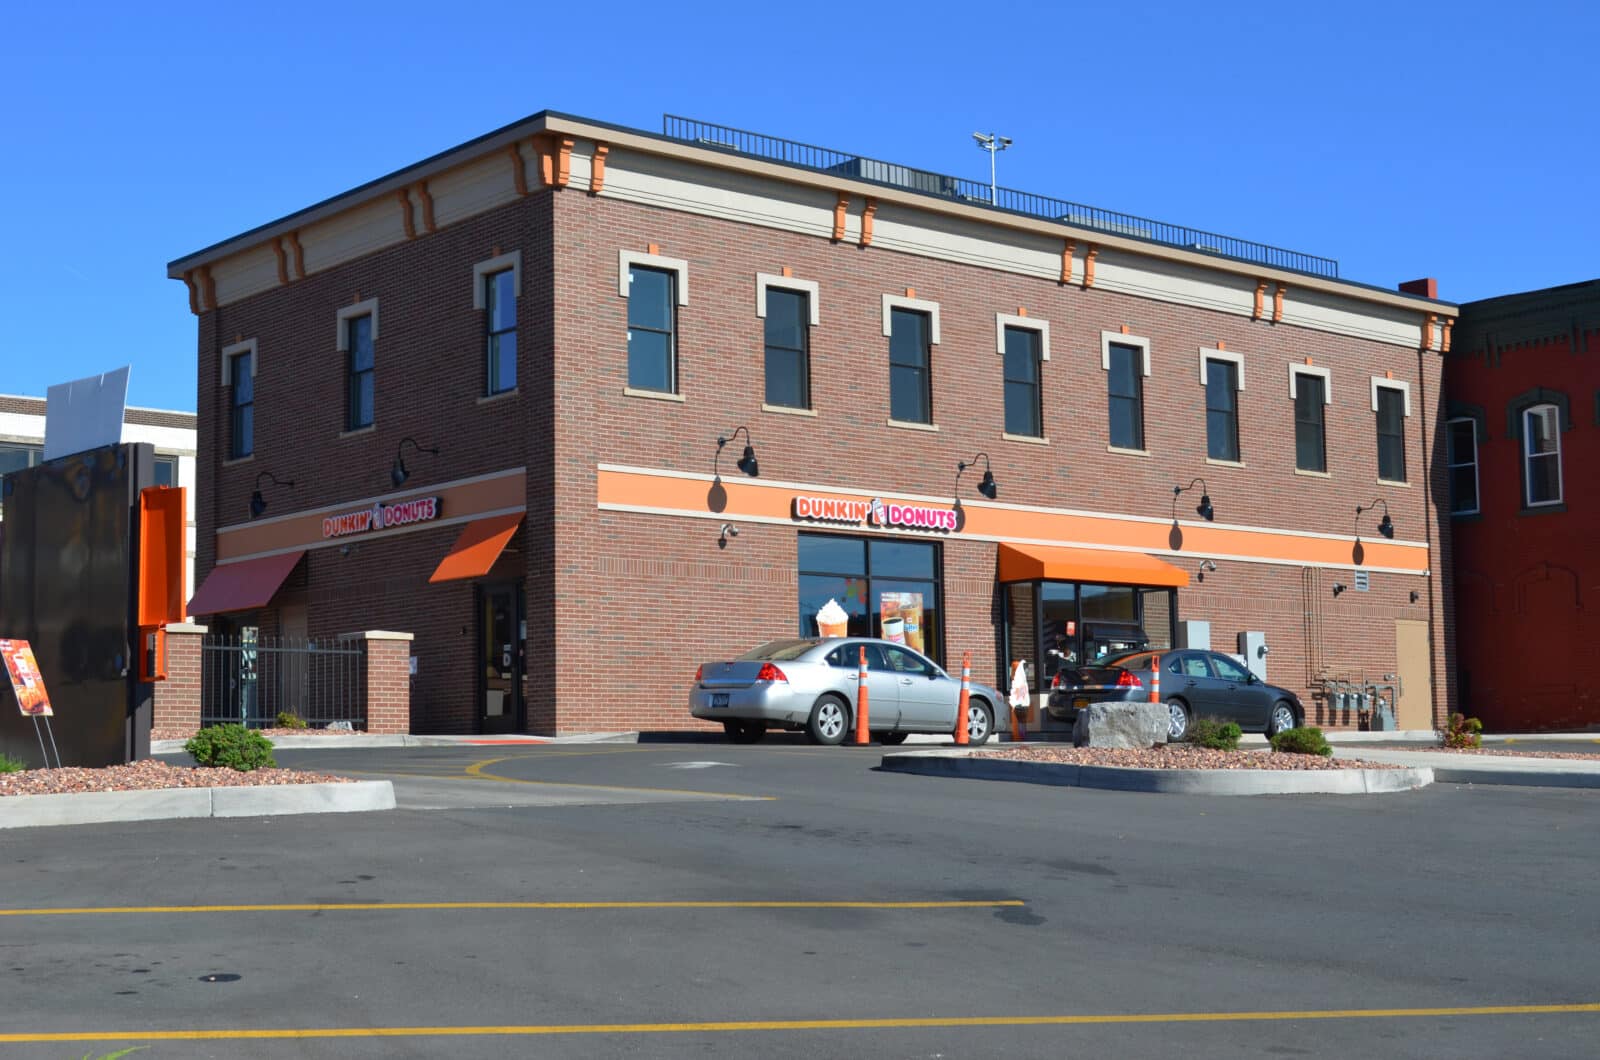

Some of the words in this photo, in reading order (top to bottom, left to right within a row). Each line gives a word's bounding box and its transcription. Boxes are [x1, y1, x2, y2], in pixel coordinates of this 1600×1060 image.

[322, 510, 372, 537] DUNKIN'
[384, 498, 435, 526] DONUTS
[797, 497, 872, 520] DUNKIN'
[890, 505, 956, 529] DONUTS
